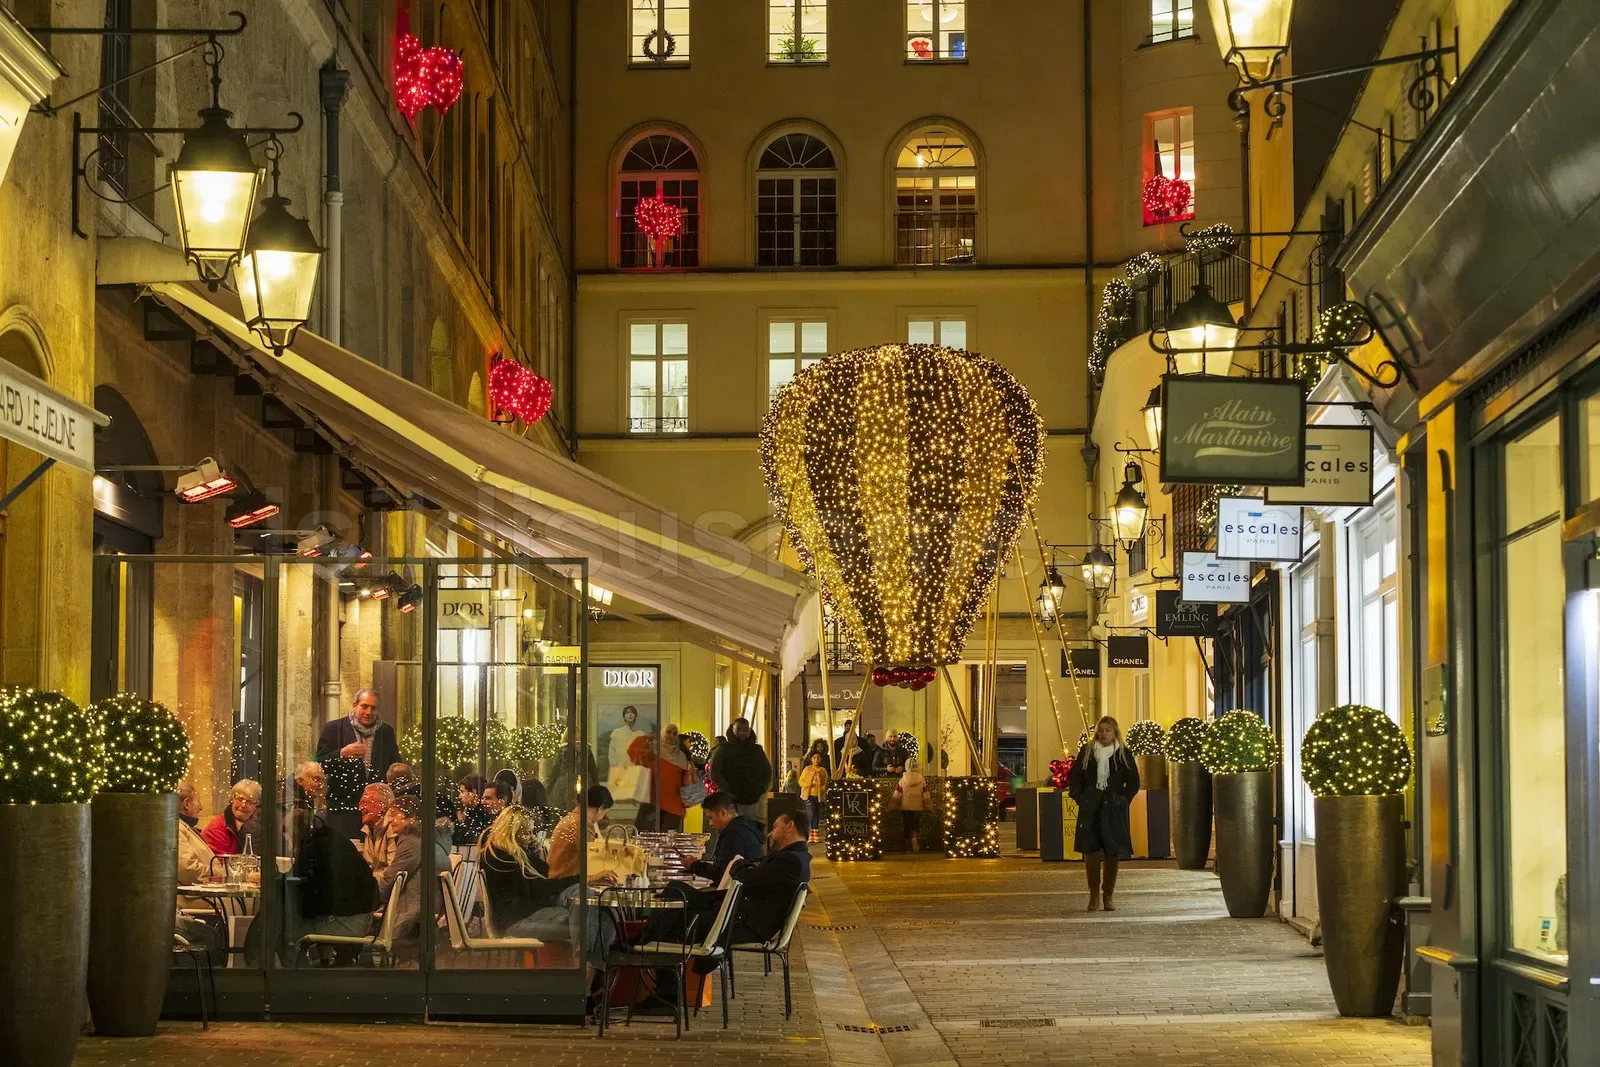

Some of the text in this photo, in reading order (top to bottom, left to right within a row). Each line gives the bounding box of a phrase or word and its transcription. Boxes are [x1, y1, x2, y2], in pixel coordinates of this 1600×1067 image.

[1203, 399, 1276, 423] Alain
[27, 395, 40, 434] LE
[42, 405, 75, 451] JEUNE
[1173, 421, 1292, 449] Martinière
[1305, 457, 1369, 473] cales
[1224, 522, 1300, 536] escales
[1188, 571, 1250, 583] escales
[442, 602, 484, 617] DIOR
[1165, 613, 1209, 622] EMLING
[1112, 657, 1144, 665] CHANEL
[604, 670, 654, 687] DIOR
